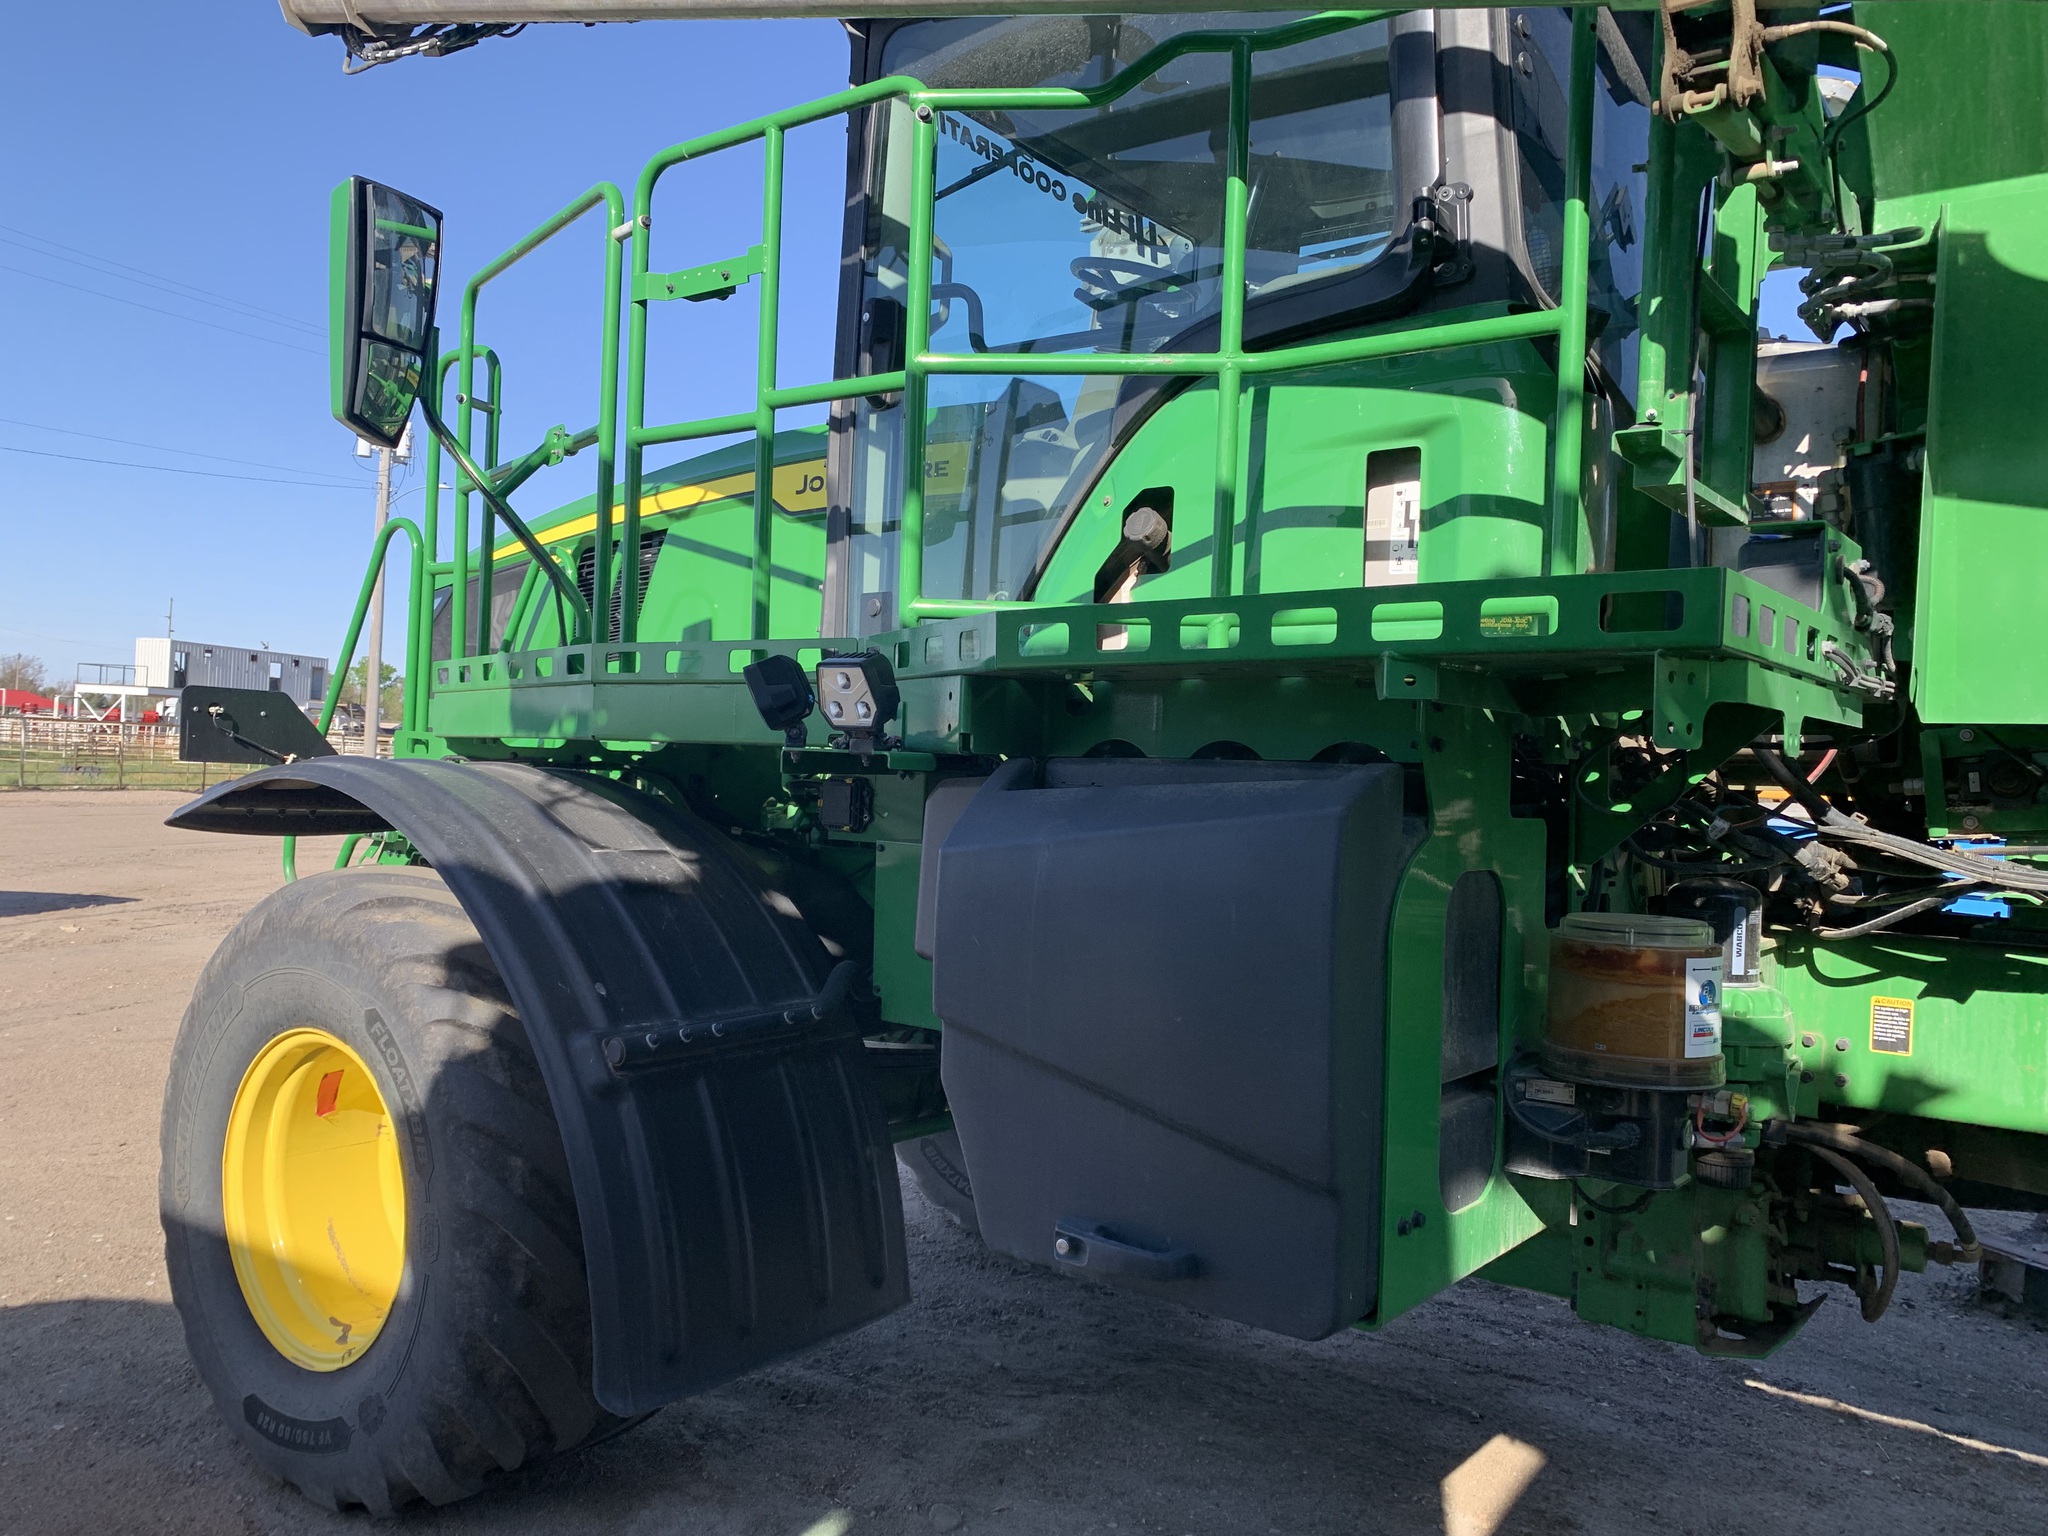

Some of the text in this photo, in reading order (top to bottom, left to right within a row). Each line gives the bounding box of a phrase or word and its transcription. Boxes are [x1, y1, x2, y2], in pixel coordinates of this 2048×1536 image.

[795, 473, 825, 495] JO
[1735, 923, 1744, 958] WABCO
[1880, 998, 1912, 1006] CAUTION
[924, 1146, 973, 1196] OATXBIB
